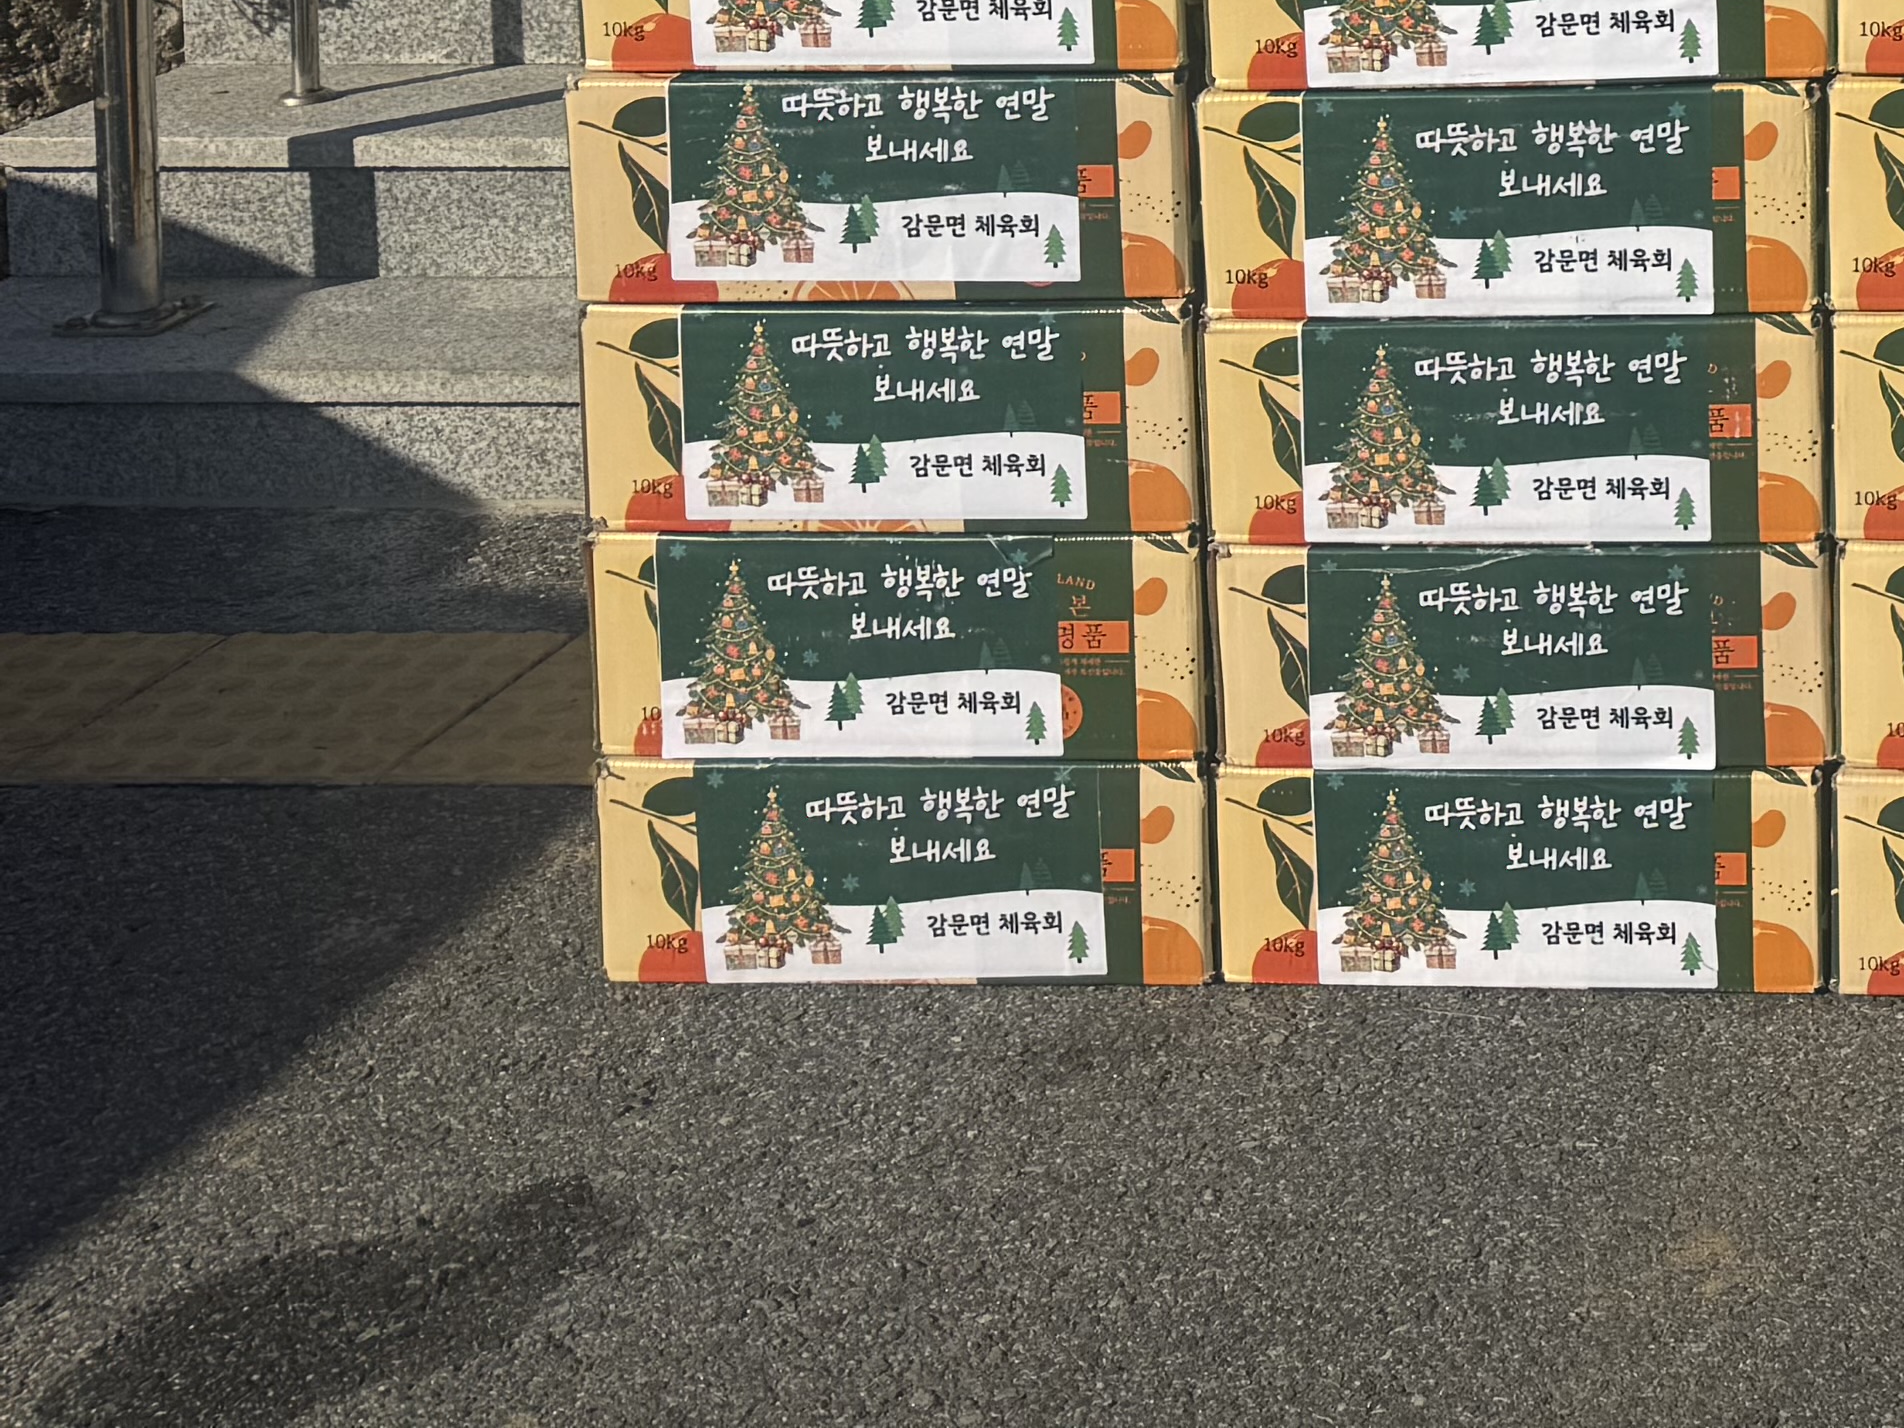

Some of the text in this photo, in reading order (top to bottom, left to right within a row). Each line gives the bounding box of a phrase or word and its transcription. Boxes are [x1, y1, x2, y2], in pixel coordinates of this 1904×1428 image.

[603, 21, 645, 42] 10kg
[1860, 21, 1903, 42] 10kg
[1414, 118, 1690, 159] 따뜻하고 행복한 연말
[1497, 168, 1609, 198] 보내세요
[1533, 247, 1673, 274] 감문면 체육회
[1226, 269, 1269, 289] 10kg
[790, 324, 1060, 365] 따뜻하고 행복한 연말
[872, 373, 982, 404] 보내세요
[909, 452, 1046, 479] 감문면 체육회
[631, 478, 672, 499] 10kg
[1417, 579, 1690, 619] 따뜻하고 행복한 연말
[1499, 627, 1610, 657] 보내세요
[1536, 705, 1674, 731] 감문면 체육회
[1860, 956, 1900, 976] 10kg
